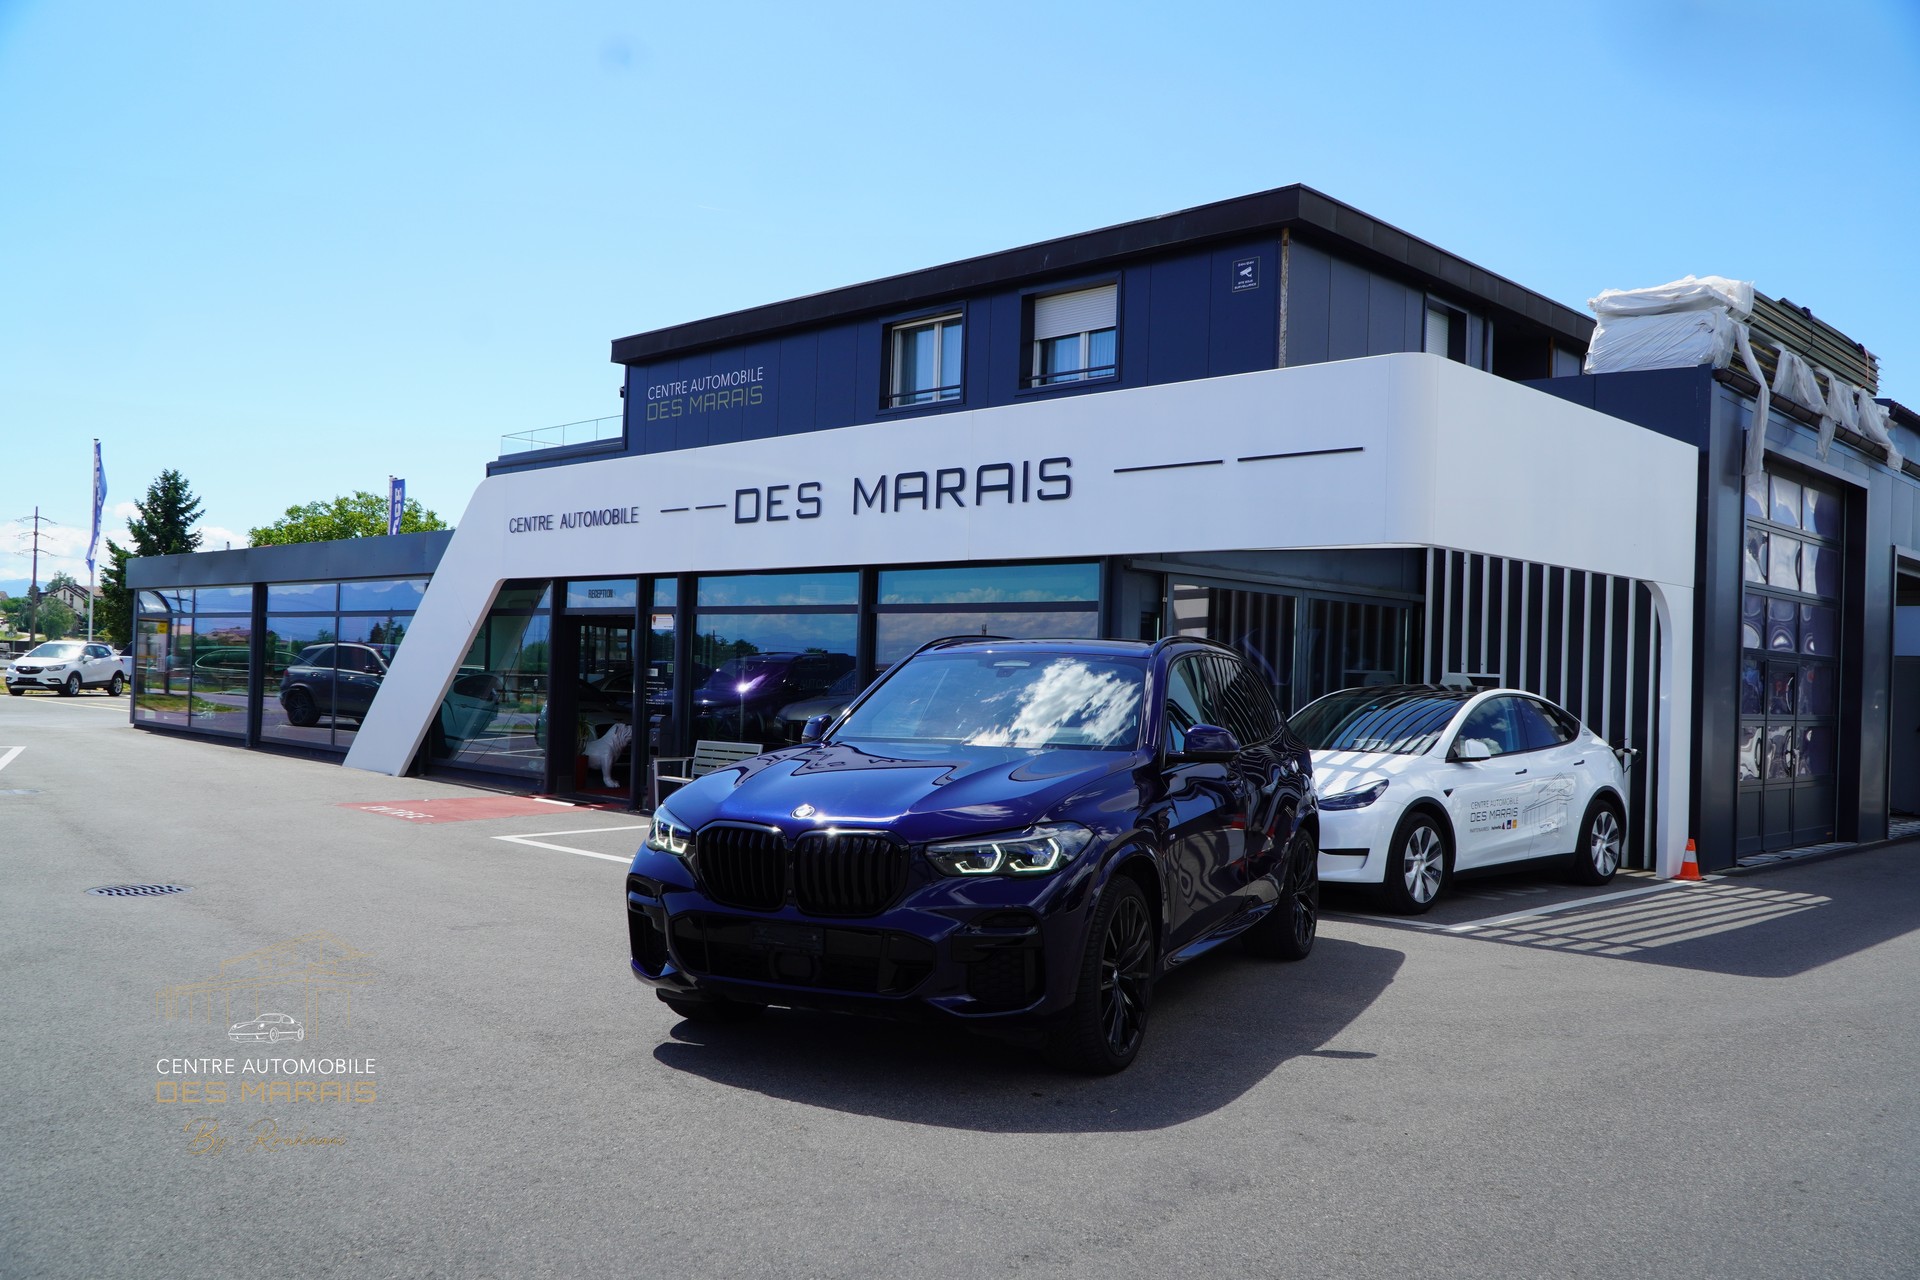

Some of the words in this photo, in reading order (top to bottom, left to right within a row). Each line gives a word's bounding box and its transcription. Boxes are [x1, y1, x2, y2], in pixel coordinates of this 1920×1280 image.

[647, 380, 687, 400] CENTRE
[690, 366, 764, 392] AUTOMOBILE
[647, 399, 683, 421] DES
[689, 385, 763, 414] MARAIS
[734, 481, 822, 524] DES
[852, 456, 1073, 515] MARAIS
[509, 514, 554, 533] CENTRE
[560, 506, 639, 529] AUTOMOBILE
[1470, 811, 1487, 823] DES
[1489, 807, 1519, 820] MARAIS
